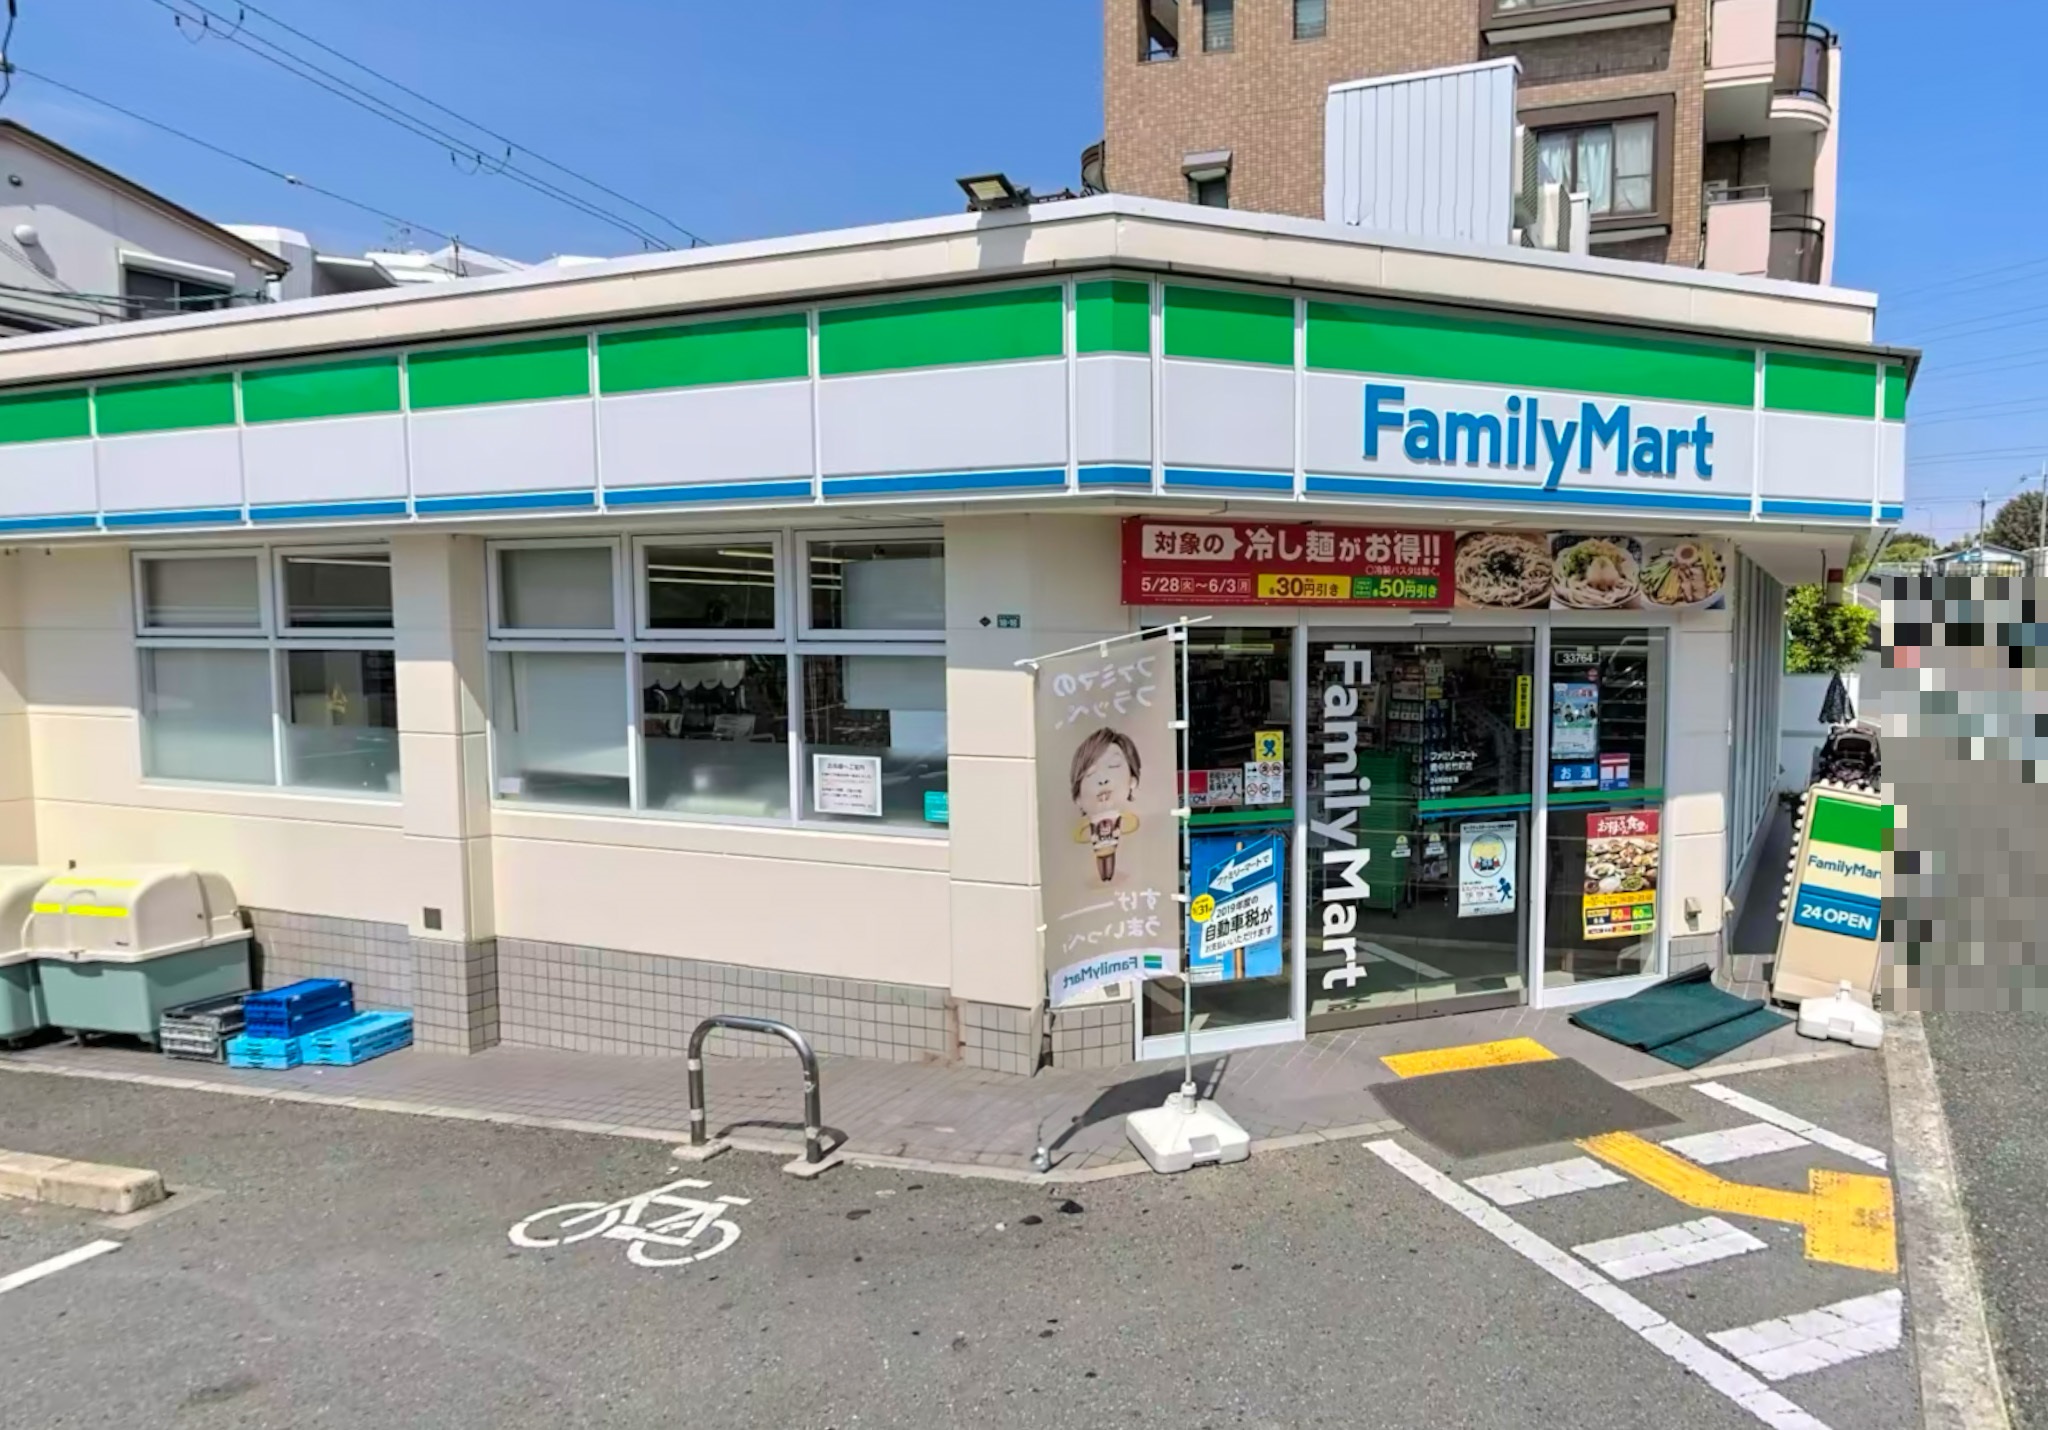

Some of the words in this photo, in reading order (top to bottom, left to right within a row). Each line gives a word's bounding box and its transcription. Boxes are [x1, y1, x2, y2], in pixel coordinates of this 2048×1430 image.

[1363, 384, 1713, 491] FamilyMart
[1154, 530, 1225, 555] 対象の
[1244, 527, 1441, 566] 冷し麺がお得!!
[1429, 750, 1478, 761] ファミリーマート
[1310, 649, 1372, 990] FamilyMart
[1807, 855, 1881, 879] FamilyMar
[1205, 905, 1273, 942] 自動車税が
[1801, 903, 1822, 920] 24
[1823, 908, 1873, 931] OPEN
